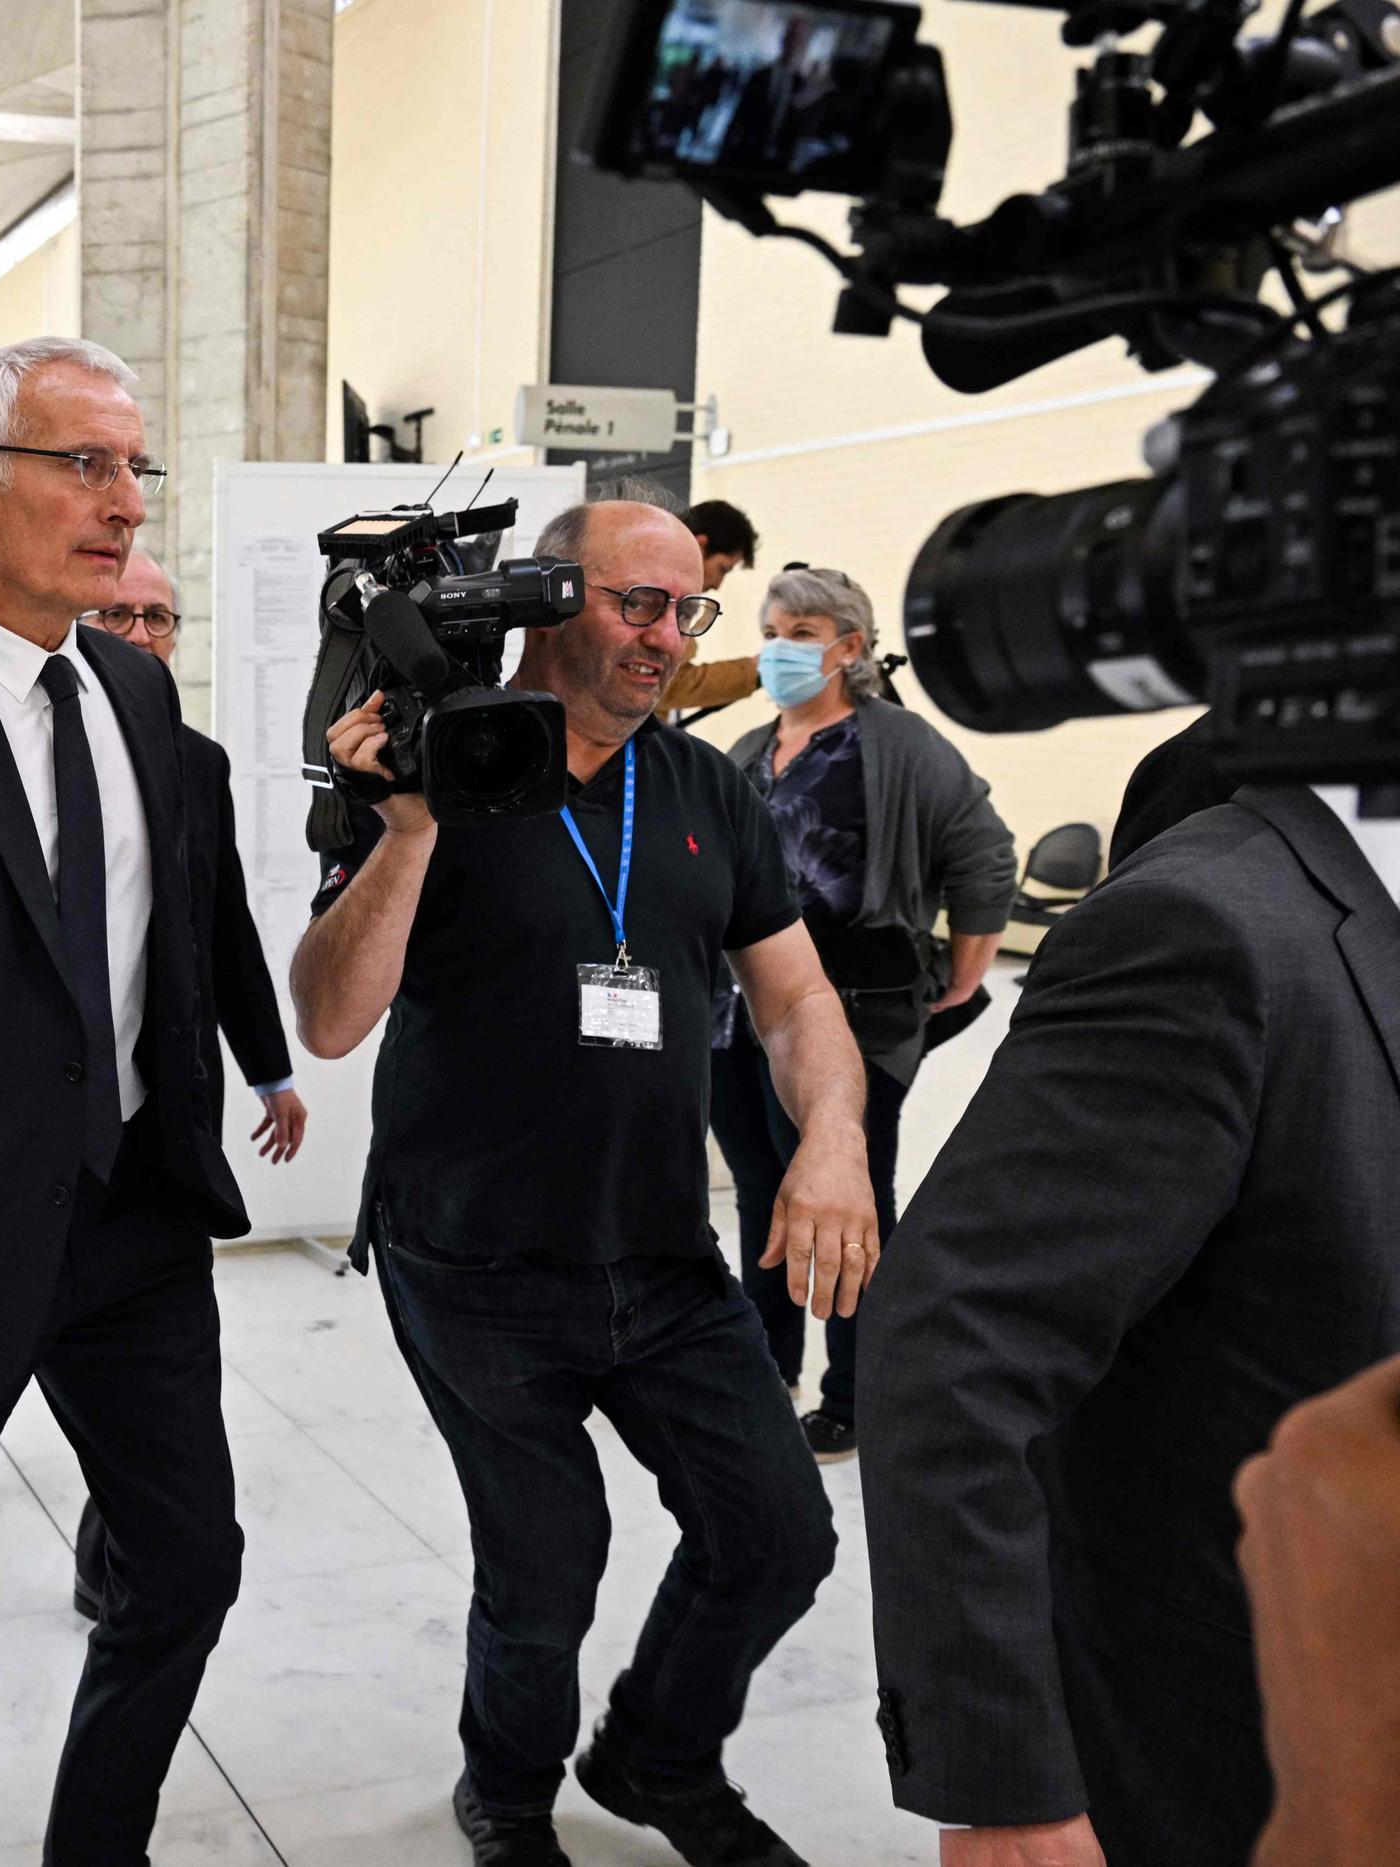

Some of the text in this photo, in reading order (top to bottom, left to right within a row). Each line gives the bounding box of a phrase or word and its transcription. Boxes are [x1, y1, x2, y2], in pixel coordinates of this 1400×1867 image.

[546, 400, 586, 416] Salle
[544, 419, 615, 436] Pénale 1
[440, 591, 467, 600] SONY
